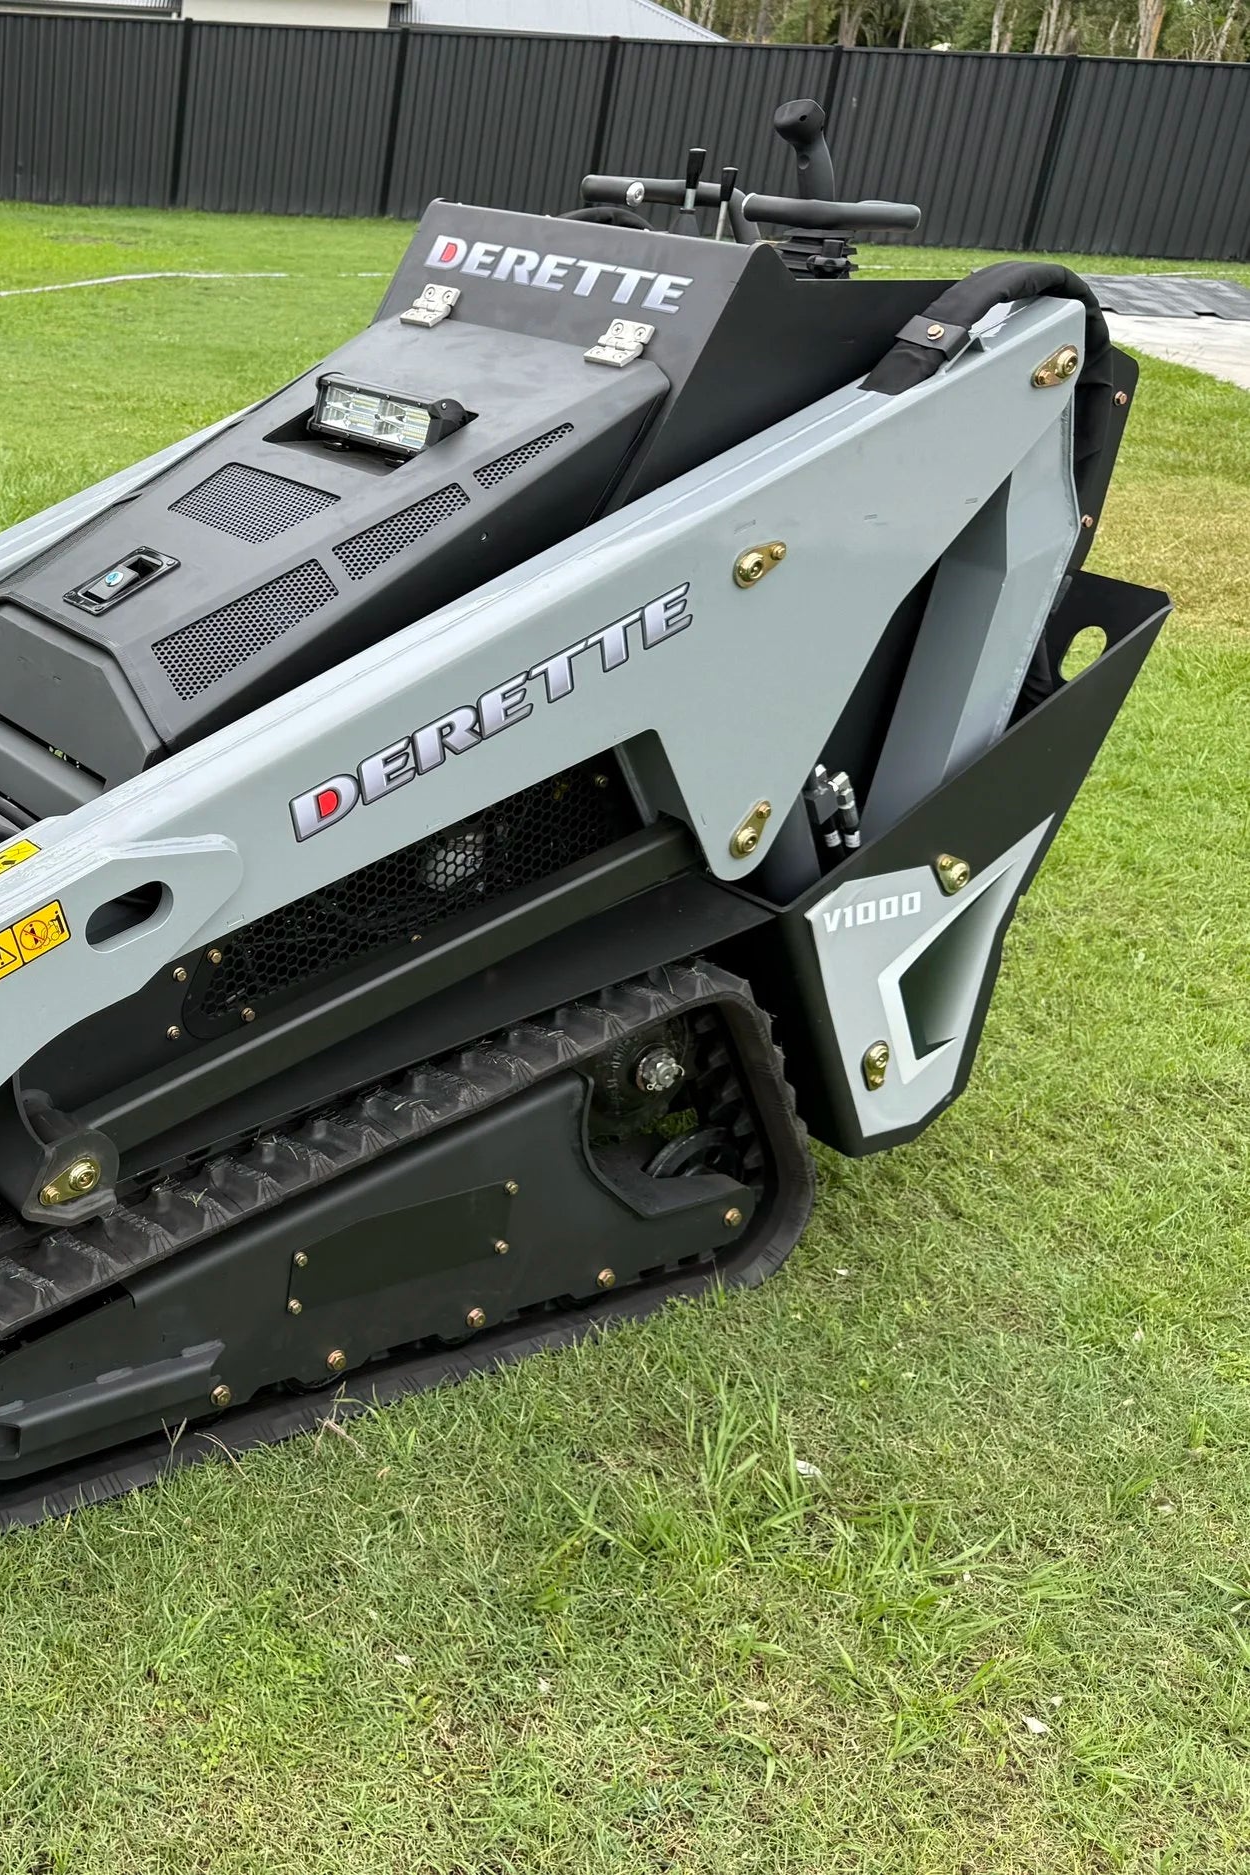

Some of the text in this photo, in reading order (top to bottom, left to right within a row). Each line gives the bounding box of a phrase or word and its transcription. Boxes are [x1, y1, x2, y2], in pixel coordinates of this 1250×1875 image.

[423, 234, 694, 315] DERETTE
[288, 581, 694, 843] DERETTE
[822, 891, 921, 933] V1000
